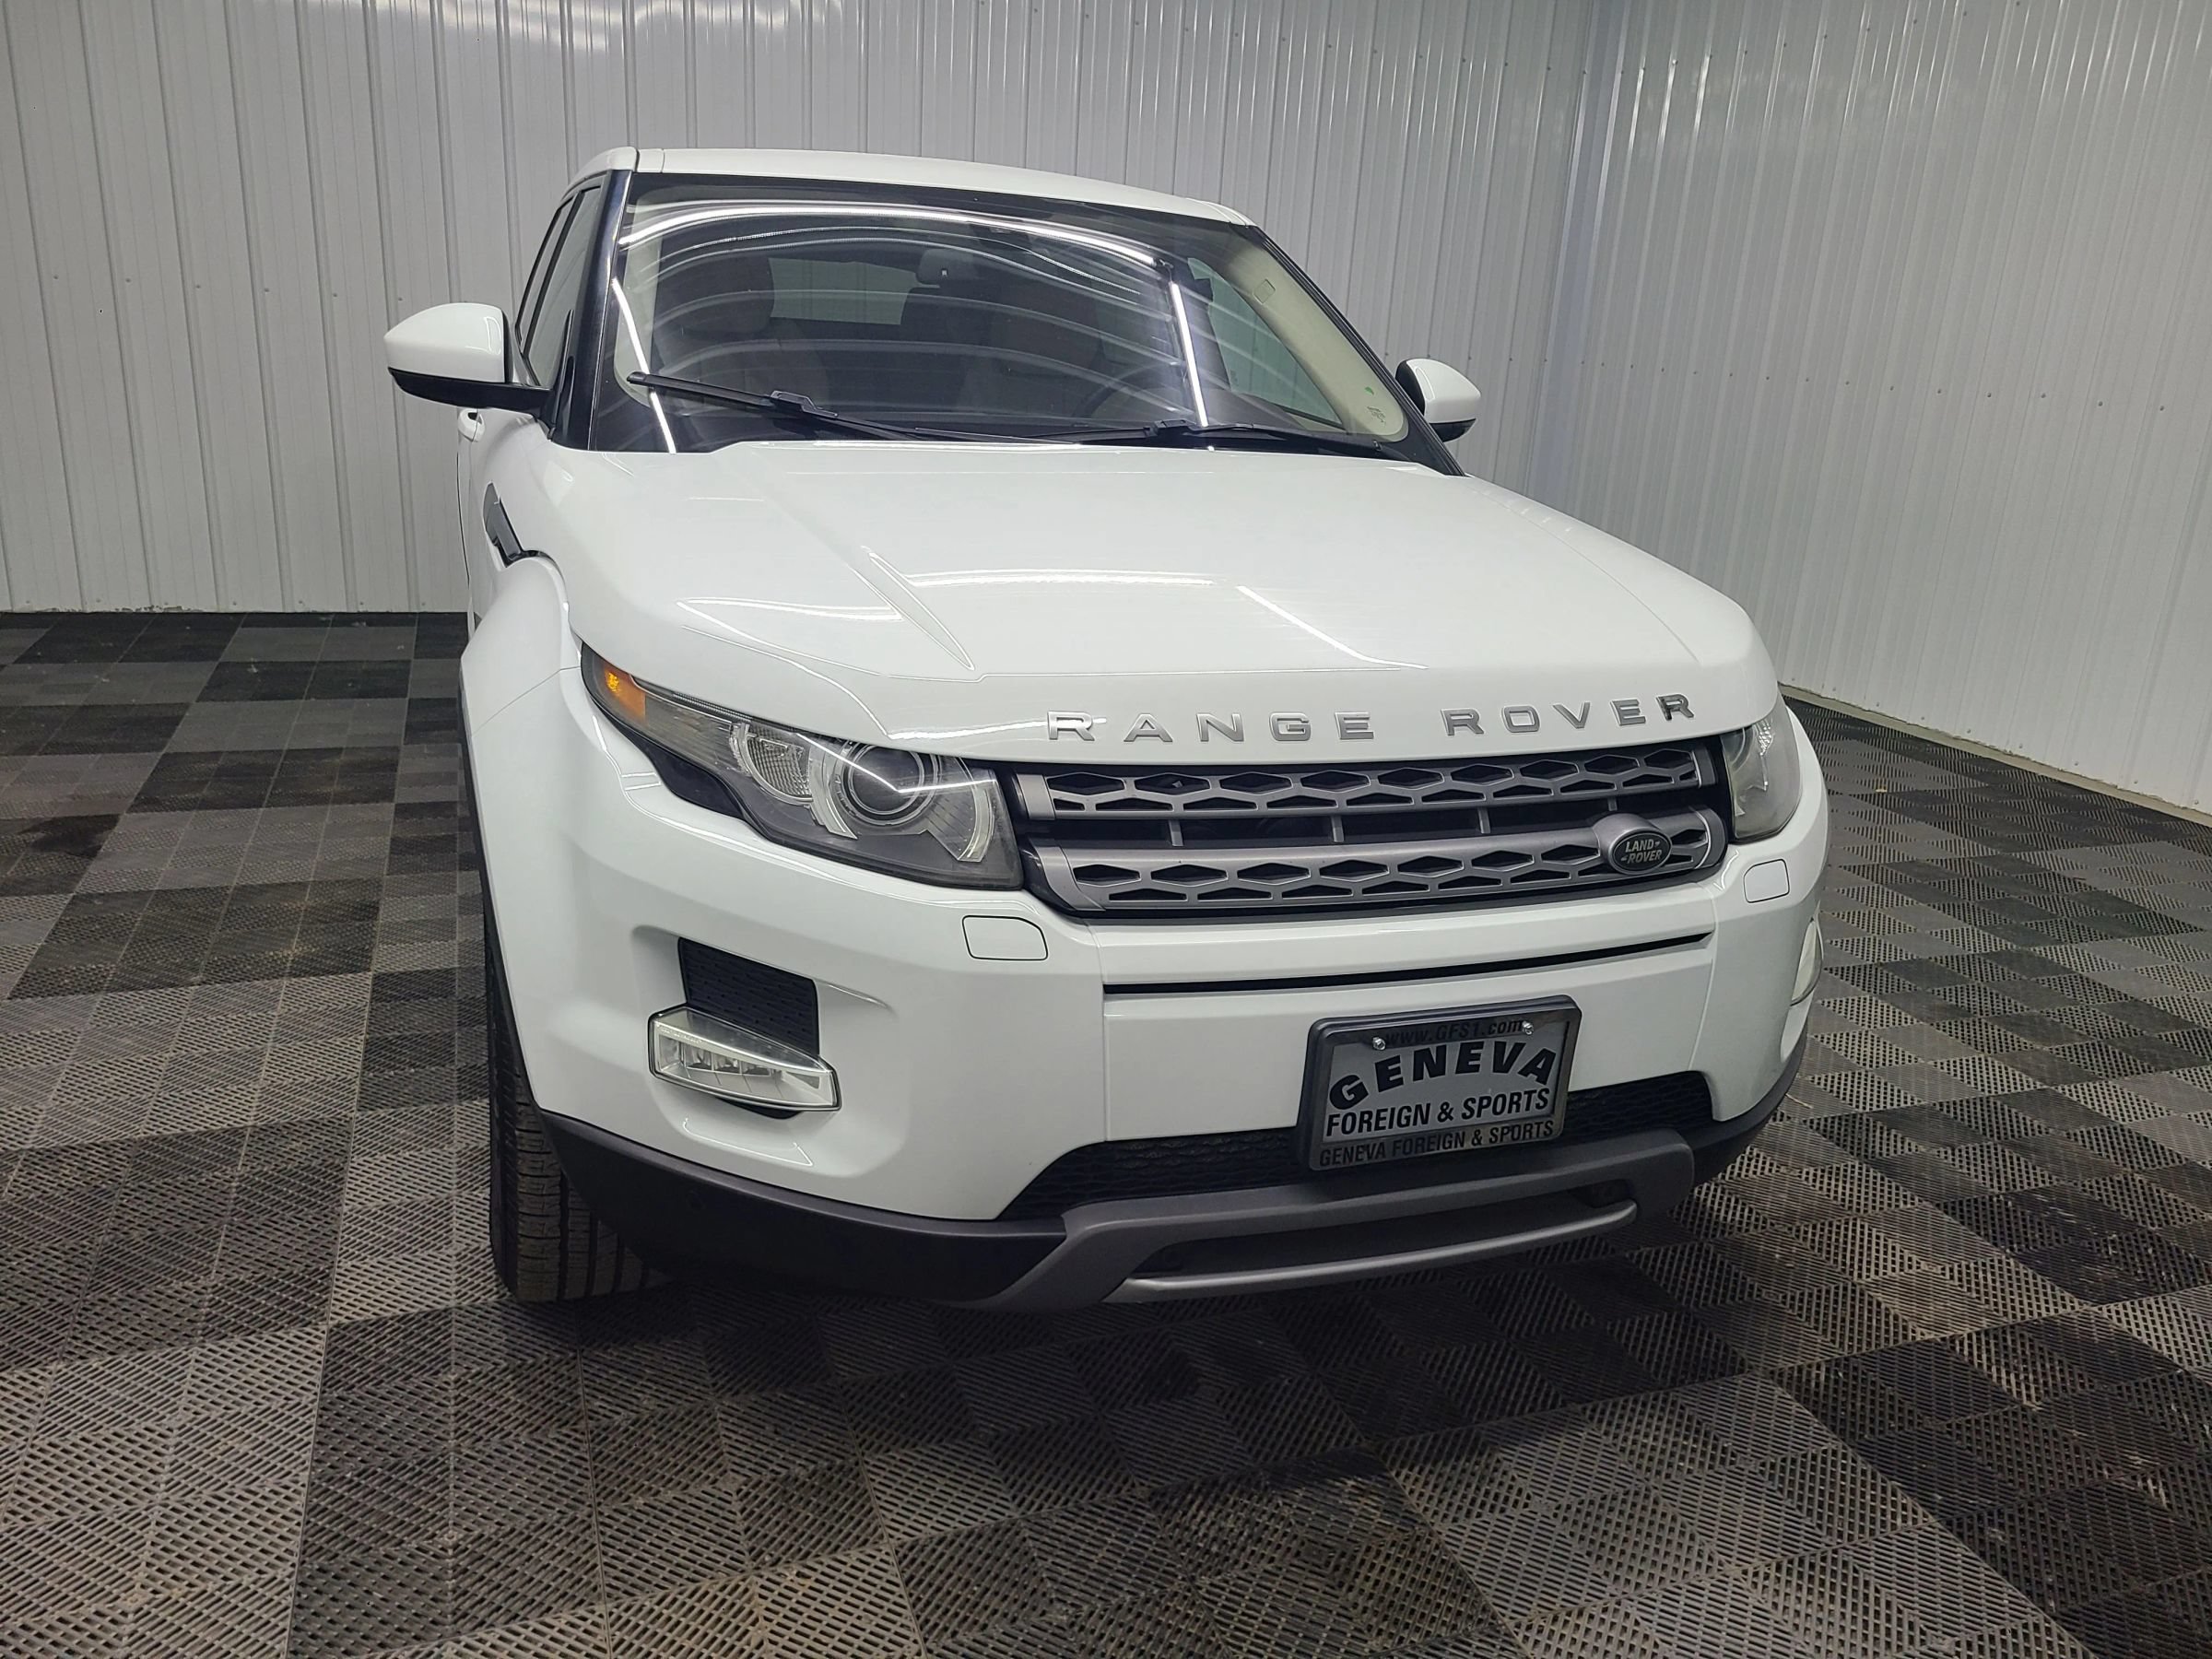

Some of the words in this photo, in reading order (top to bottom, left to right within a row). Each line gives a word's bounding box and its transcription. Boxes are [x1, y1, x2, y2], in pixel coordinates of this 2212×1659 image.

[1047, 710, 1374, 743] RANGE
[1441, 693, 1695, 735] ROVER
[1625, 839, 1653, 853] LAND
[1628, 850, 1662, 864] ROVER
[1386, 1019, 1522, 1044] www.GFS1.com
[1329, 1041, 1557, 1110] GENEVA
[1326, 1103, 1430, 1136] FOREIGN
[1437, 1101, 1454, 1123] &
[1461, 1088, 1550, 1120] SPORTS
[1320, 1143, 1386, 1167] GENEVA
[1393, 1131, 1465, 1157] FOREIGN
[1471, 1129, 1484, 1147] &
[1488, 1120, 1554, 1145] SPORTS
